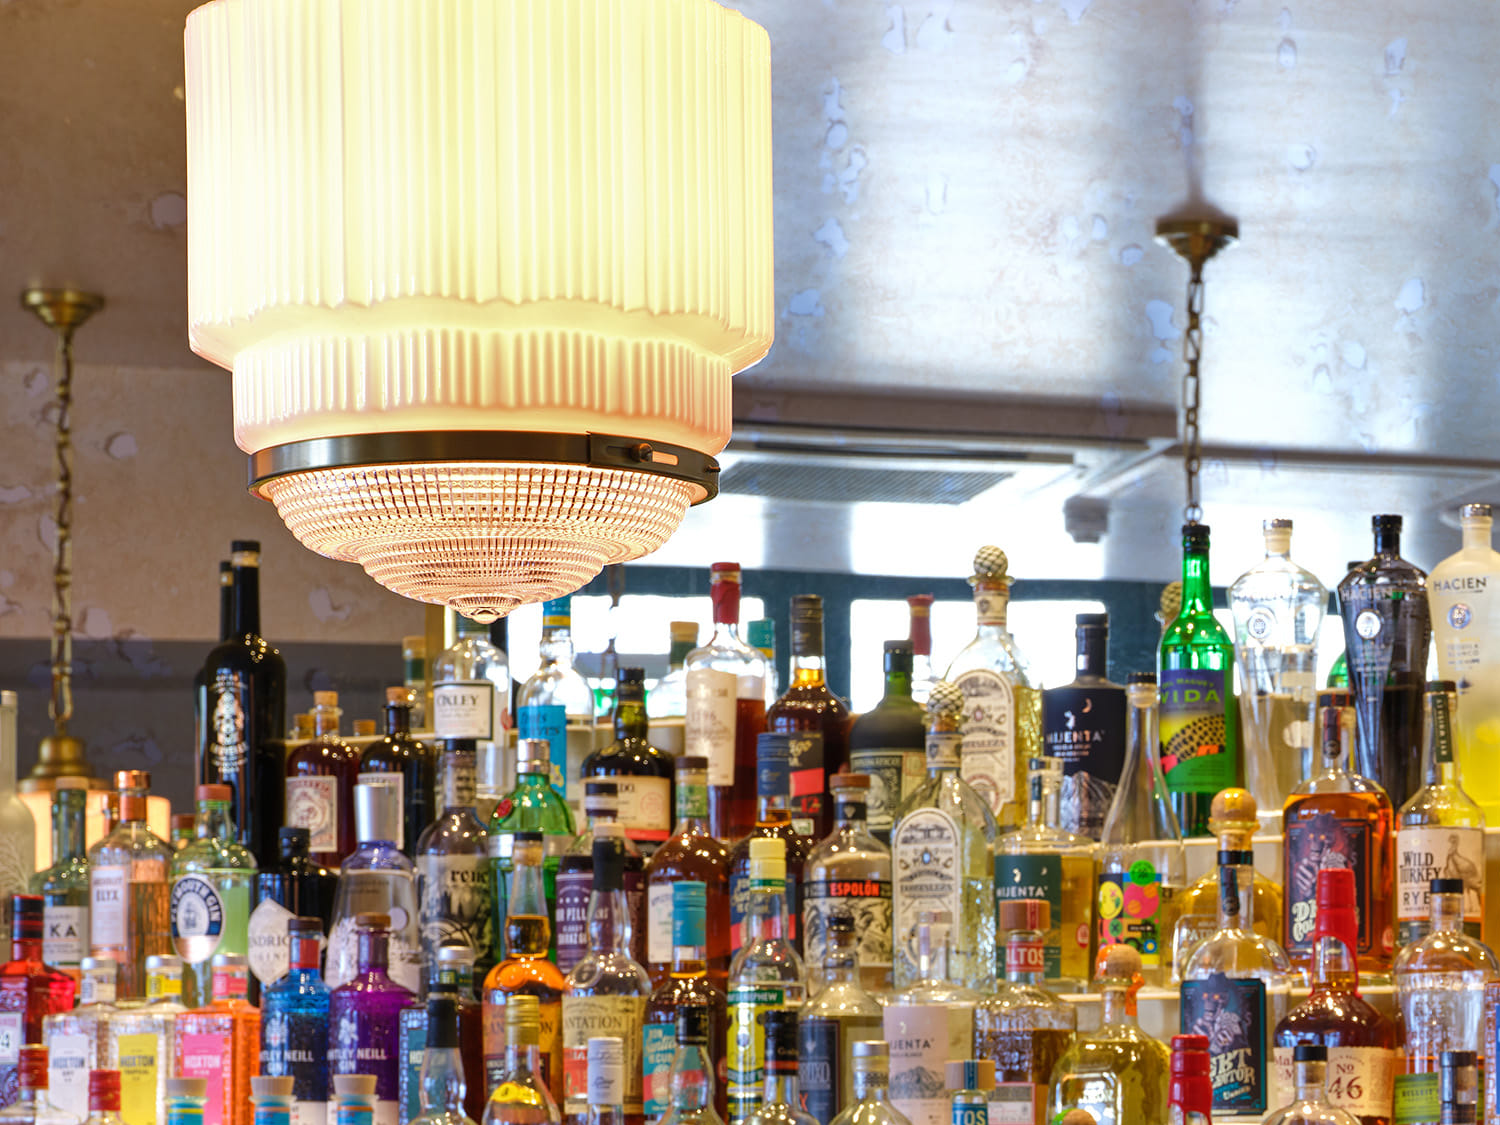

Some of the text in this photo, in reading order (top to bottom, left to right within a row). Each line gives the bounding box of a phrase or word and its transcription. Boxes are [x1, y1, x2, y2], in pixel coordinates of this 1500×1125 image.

[1433, 577, 1487, 592] HACIEN
[890, 1038, 932, 1050] IJENTA
[284, 1050, 314, 1062] NEILL
[357, 1047, 388, 1060] NEILL
[1328, 1074, 1364, 1101] 46
